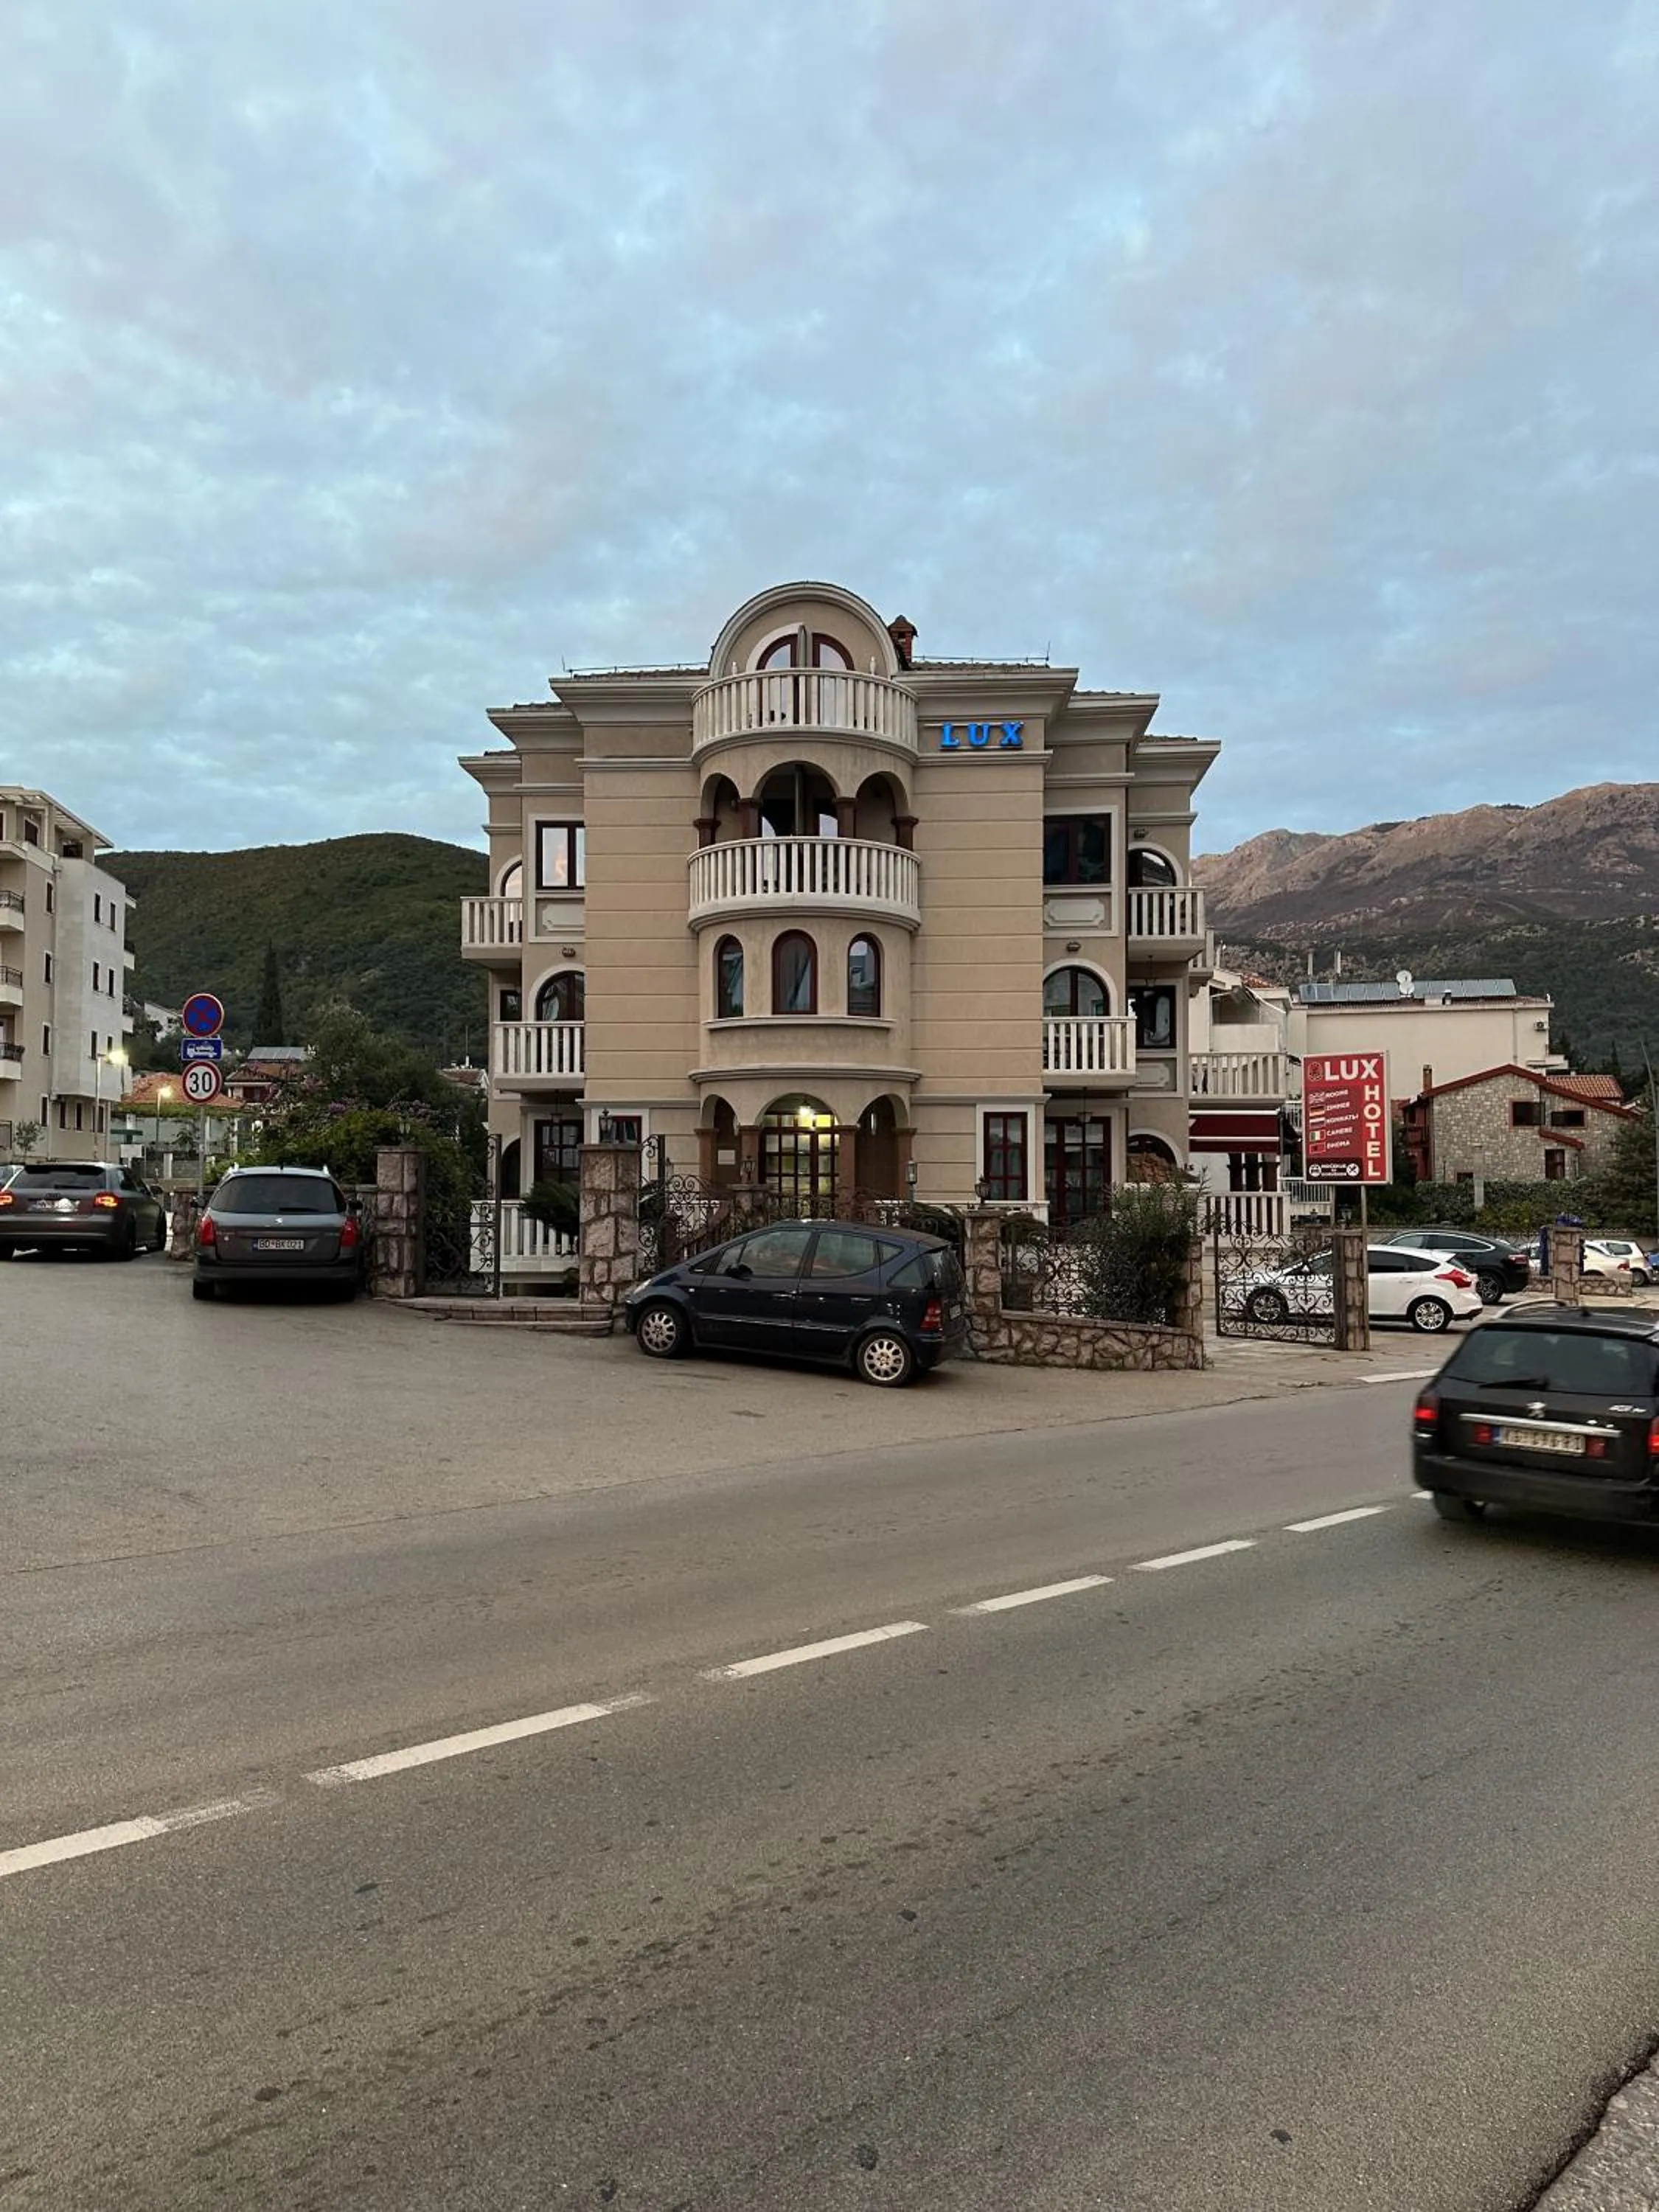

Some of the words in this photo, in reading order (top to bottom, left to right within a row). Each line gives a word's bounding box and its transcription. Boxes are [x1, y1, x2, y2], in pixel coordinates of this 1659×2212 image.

[941, 721, 1023, 747] LUX
[1324, 1058, 1379, 1081] LUX
[189, 1072, 212, 1093] 30
[1363, 1085, 1381, 1176] HOTEL
